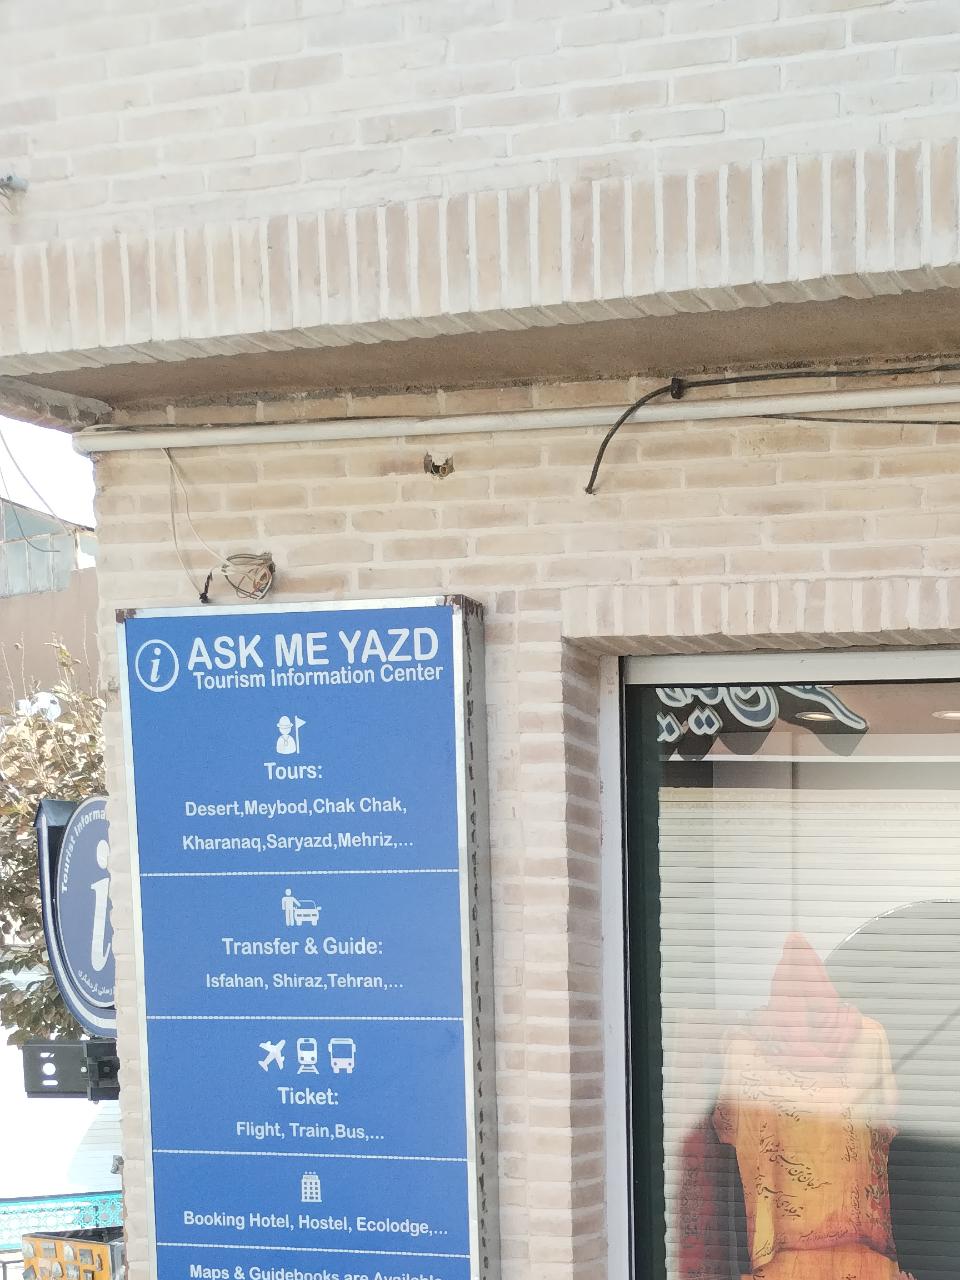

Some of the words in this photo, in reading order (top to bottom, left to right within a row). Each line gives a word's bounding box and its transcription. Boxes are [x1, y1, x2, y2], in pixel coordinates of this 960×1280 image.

[188, 635, 263, 670] ASK
[275, 632, 329, 666] ME
[339, 627, 438, 664] YAZD
[193, 670, 265, 689] Tourism
[271, 668, 374, 686] Information
[380, 663, 443, 682] Center
[264, 762, 322, 779] Tours:
[61, 836, 76, 894] Tourist
[222, 938, 299, 954] Transfer
[305, 937, 318, 954] &
[323, 937, 382, 954] Guide:
[207, 974, 268, 989] Isfahan,
[278, 1087, 338, 1105] Ticket:
[237, 1122, 284, 1139] Flight,
[184, 1211, 244, 1230] Booking
[250, 1213, 293, 1230] Hotel,
[299, 1215, 352, 1233] Hostel,
[190, 1265, 229, 1280] Maps
[234, 1266, 245, 1279] &
